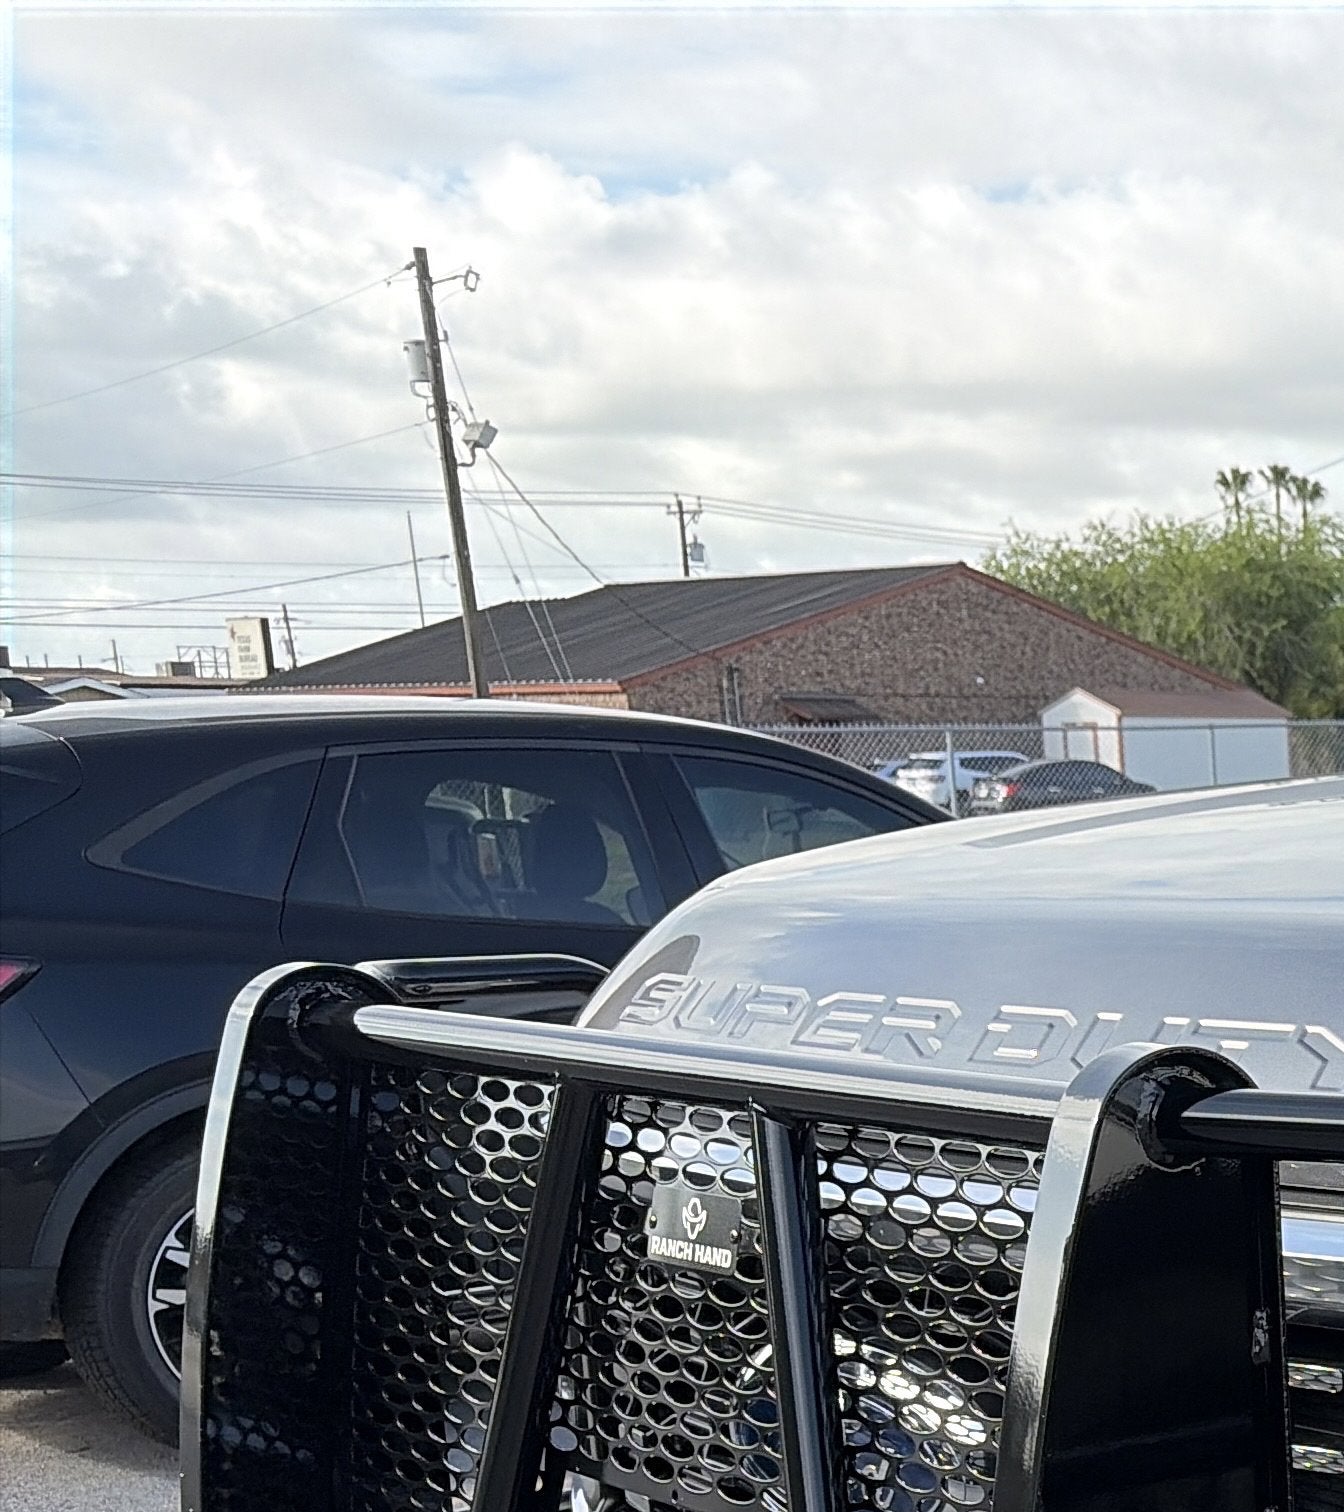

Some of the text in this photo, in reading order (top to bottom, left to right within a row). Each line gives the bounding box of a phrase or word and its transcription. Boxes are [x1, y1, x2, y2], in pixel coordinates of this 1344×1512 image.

[618, 972, 962, 1058] SUPER
[651, 1235, 733, 1269] RANCH HAND
